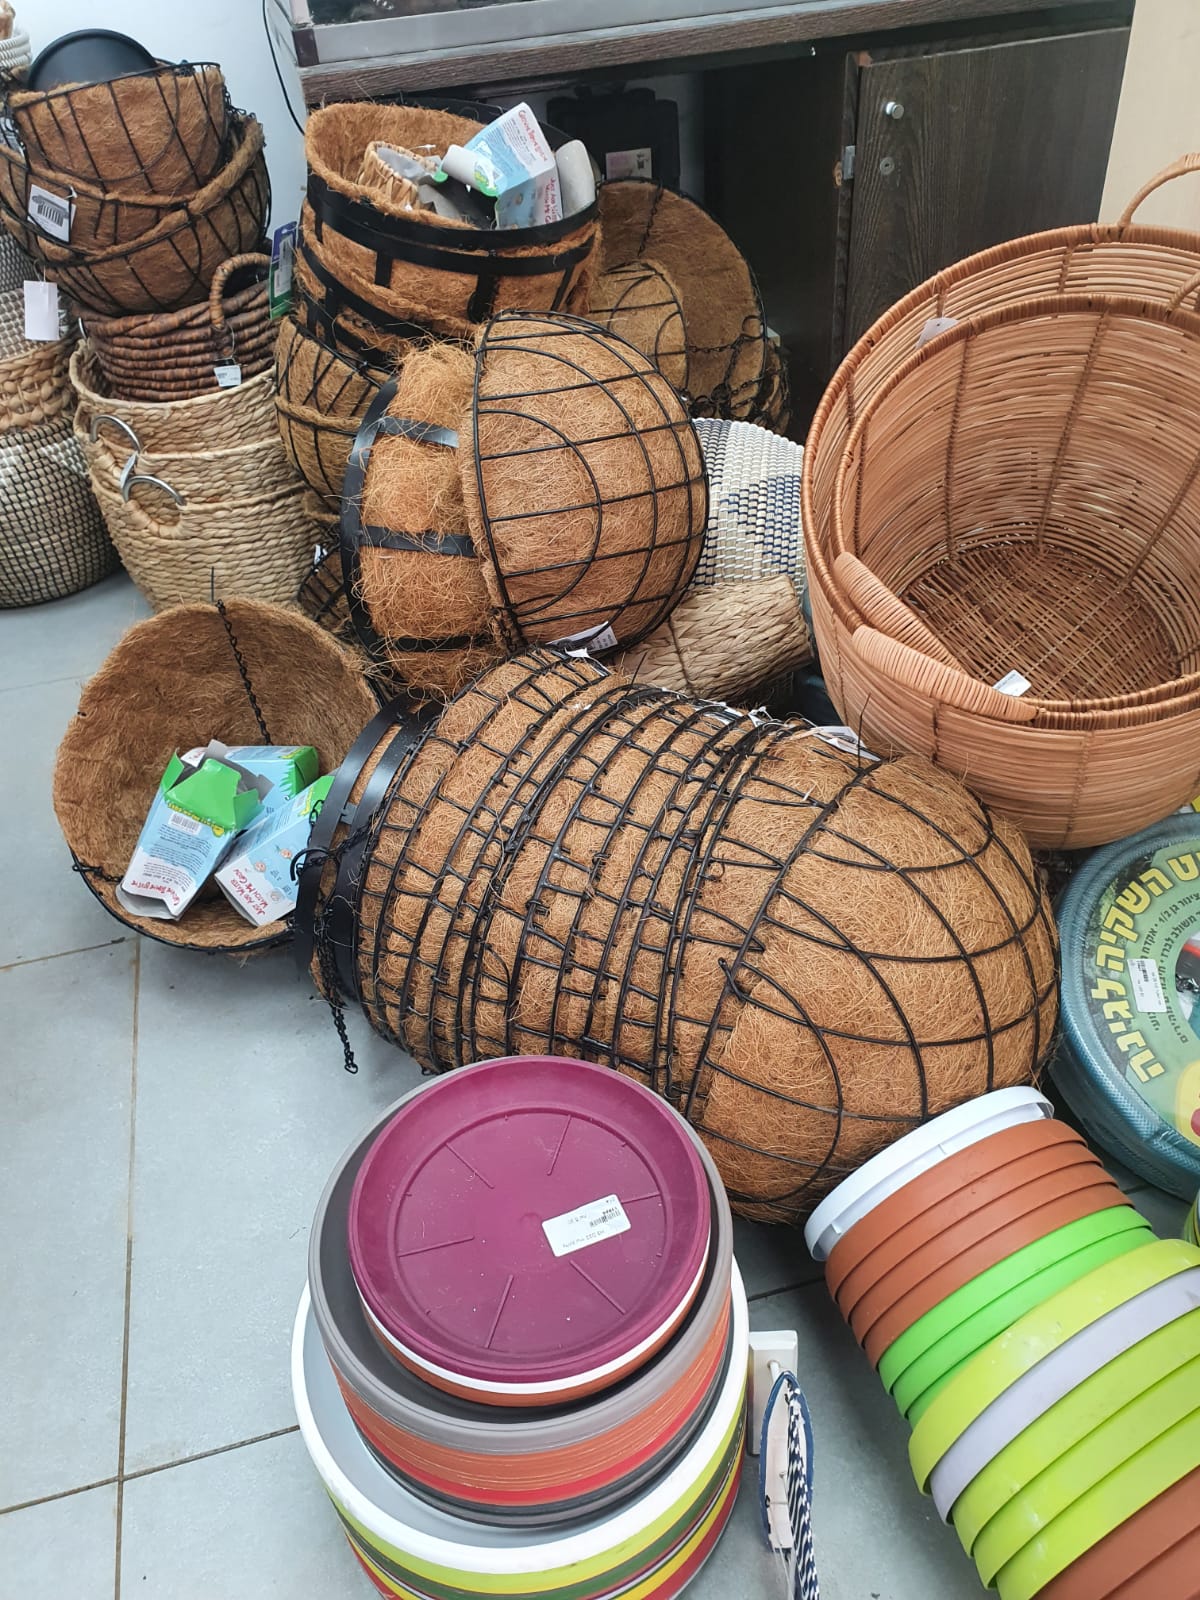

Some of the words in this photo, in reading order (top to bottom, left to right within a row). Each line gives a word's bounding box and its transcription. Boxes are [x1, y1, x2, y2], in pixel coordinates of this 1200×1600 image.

[1167, 852, 1200, 881] ט
[1169, 904, 1180, 914] גן
[1178, 893, 1200, 906] צינור
[1096, 868, 1174, 972] השקיה
[1171, 915, 1197, 938] משולב
[1142, 928, 1157, 954] אקדח
[1161, 937, 1174, 958] לברז
[1091, 978, 1165, 1083] לגינה
